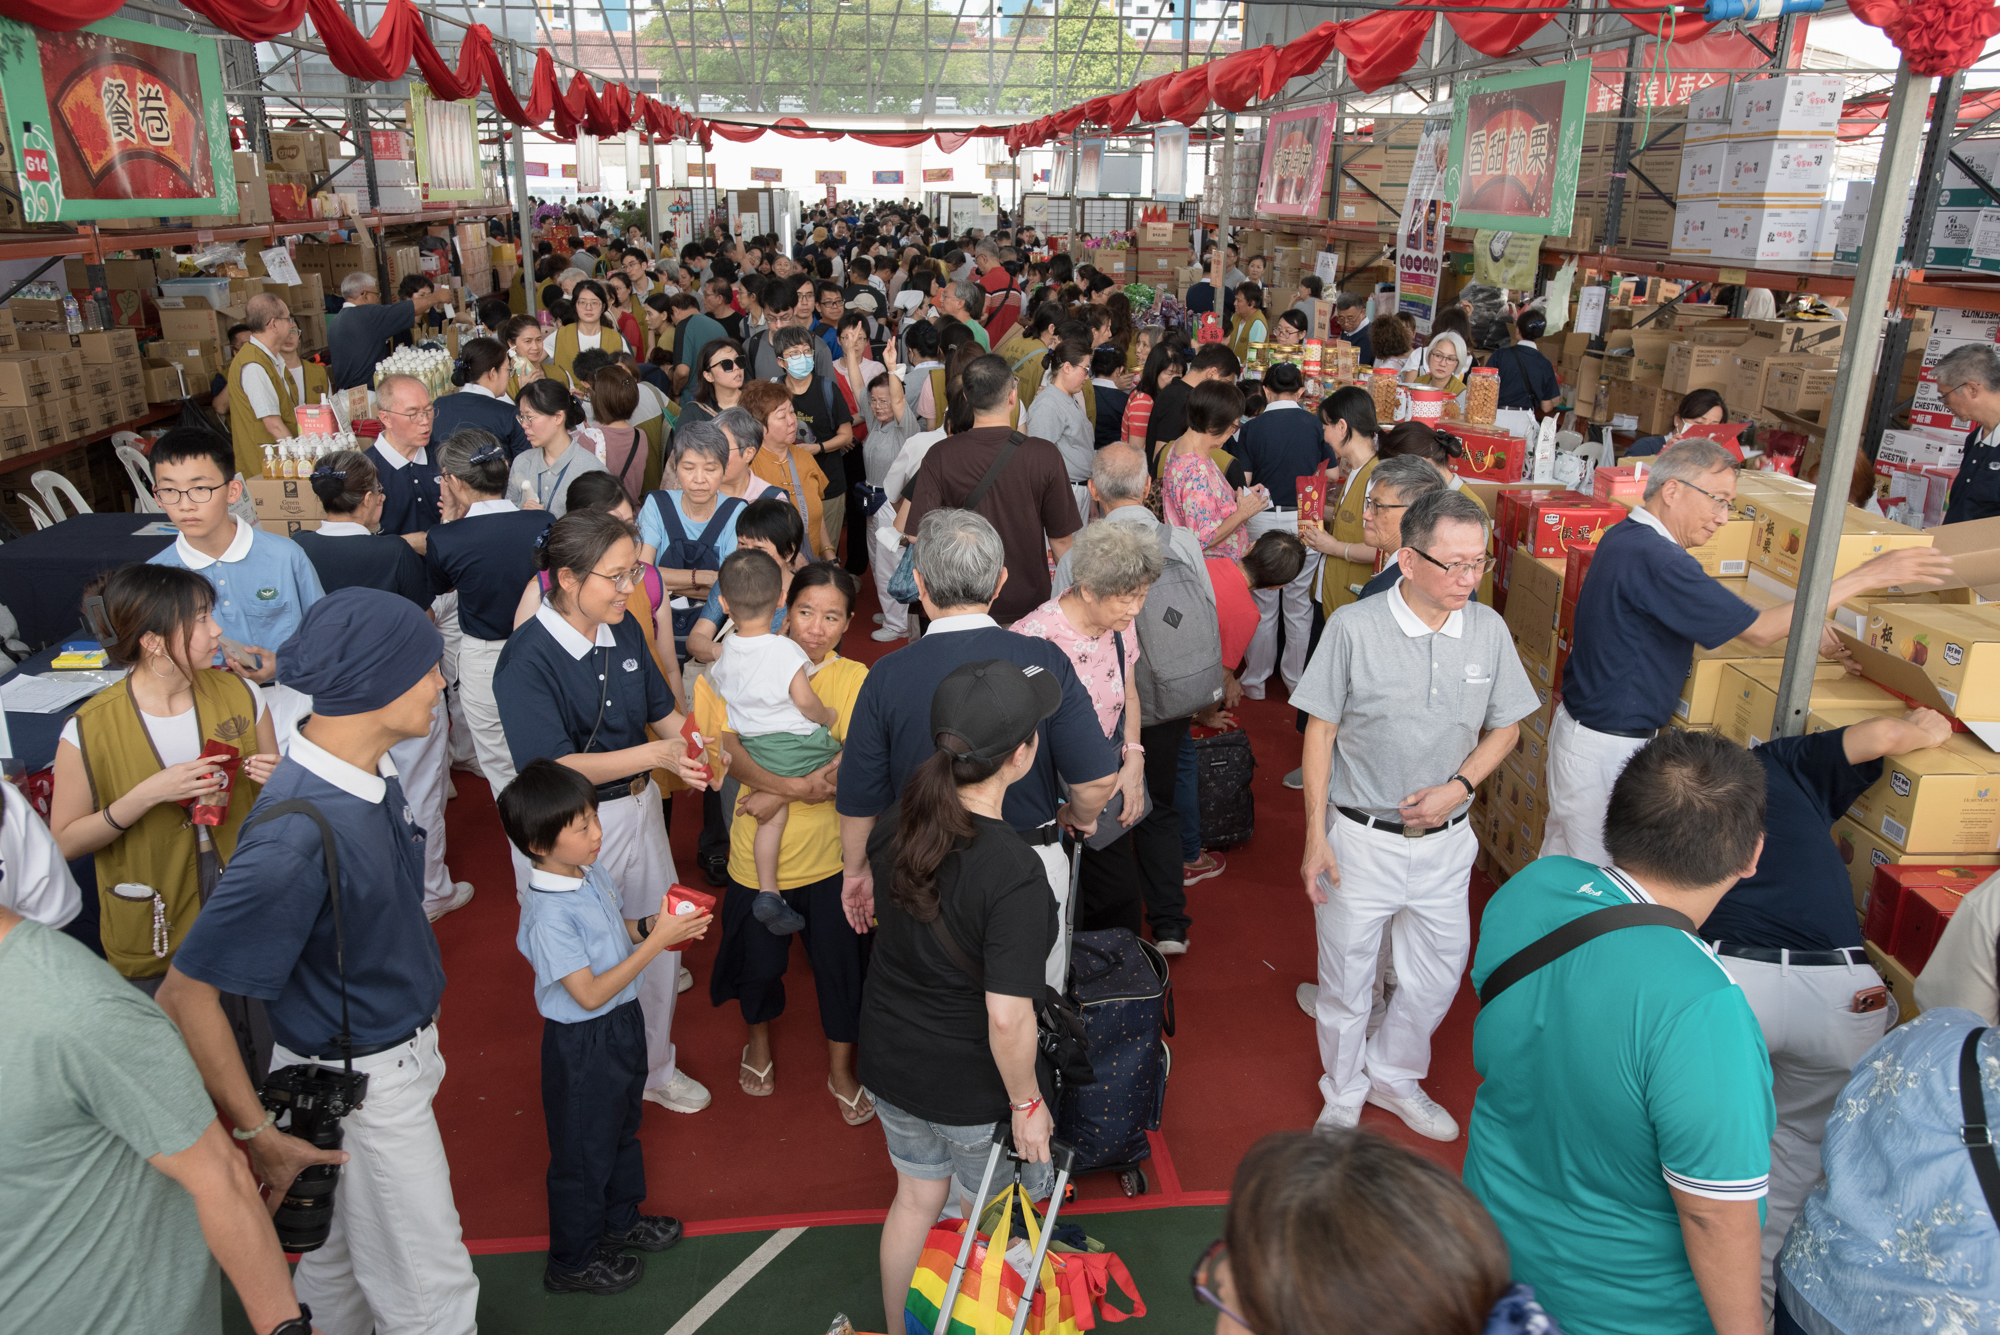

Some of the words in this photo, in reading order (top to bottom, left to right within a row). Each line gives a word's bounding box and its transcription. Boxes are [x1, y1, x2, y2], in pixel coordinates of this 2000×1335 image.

[25, 157, 48, 172] G14
[1914, 401, 1951, 413] CHESTNUTS
[1879, 451, 1916, 463] CHESTNUS
[1945, 653, 1960, 661] Fortune
